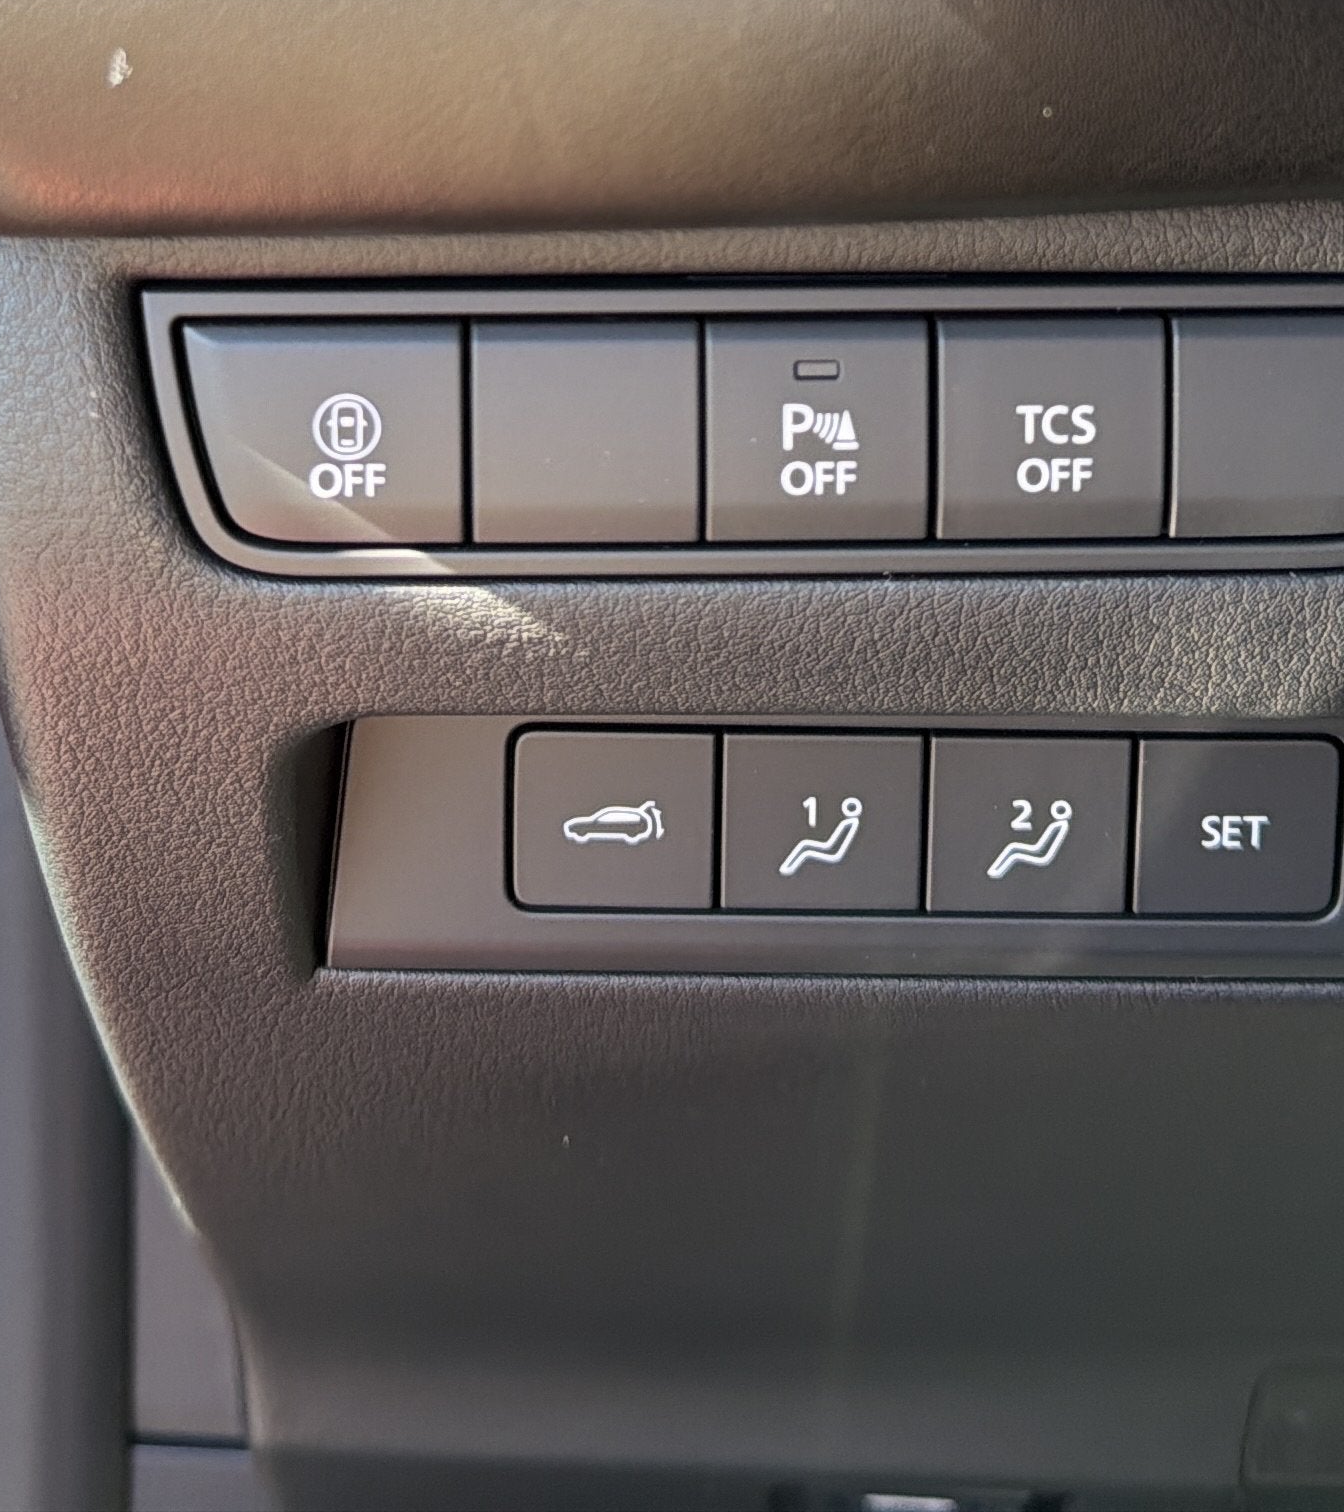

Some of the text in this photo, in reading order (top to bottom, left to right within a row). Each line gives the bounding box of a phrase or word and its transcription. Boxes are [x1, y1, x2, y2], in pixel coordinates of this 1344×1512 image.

[782, 403, 815, 451] P
[1015, 403, 1096, 445] TCS
[309, 461, 386, 499] OFF
[780, 460, 858, 496] OFF
[1016, 457, 1093, 493] OFF
[801, 796, 817, 828] 1
[1010, 799, 1032, 831] 2
[1200, 814, 1269, 850] SET
